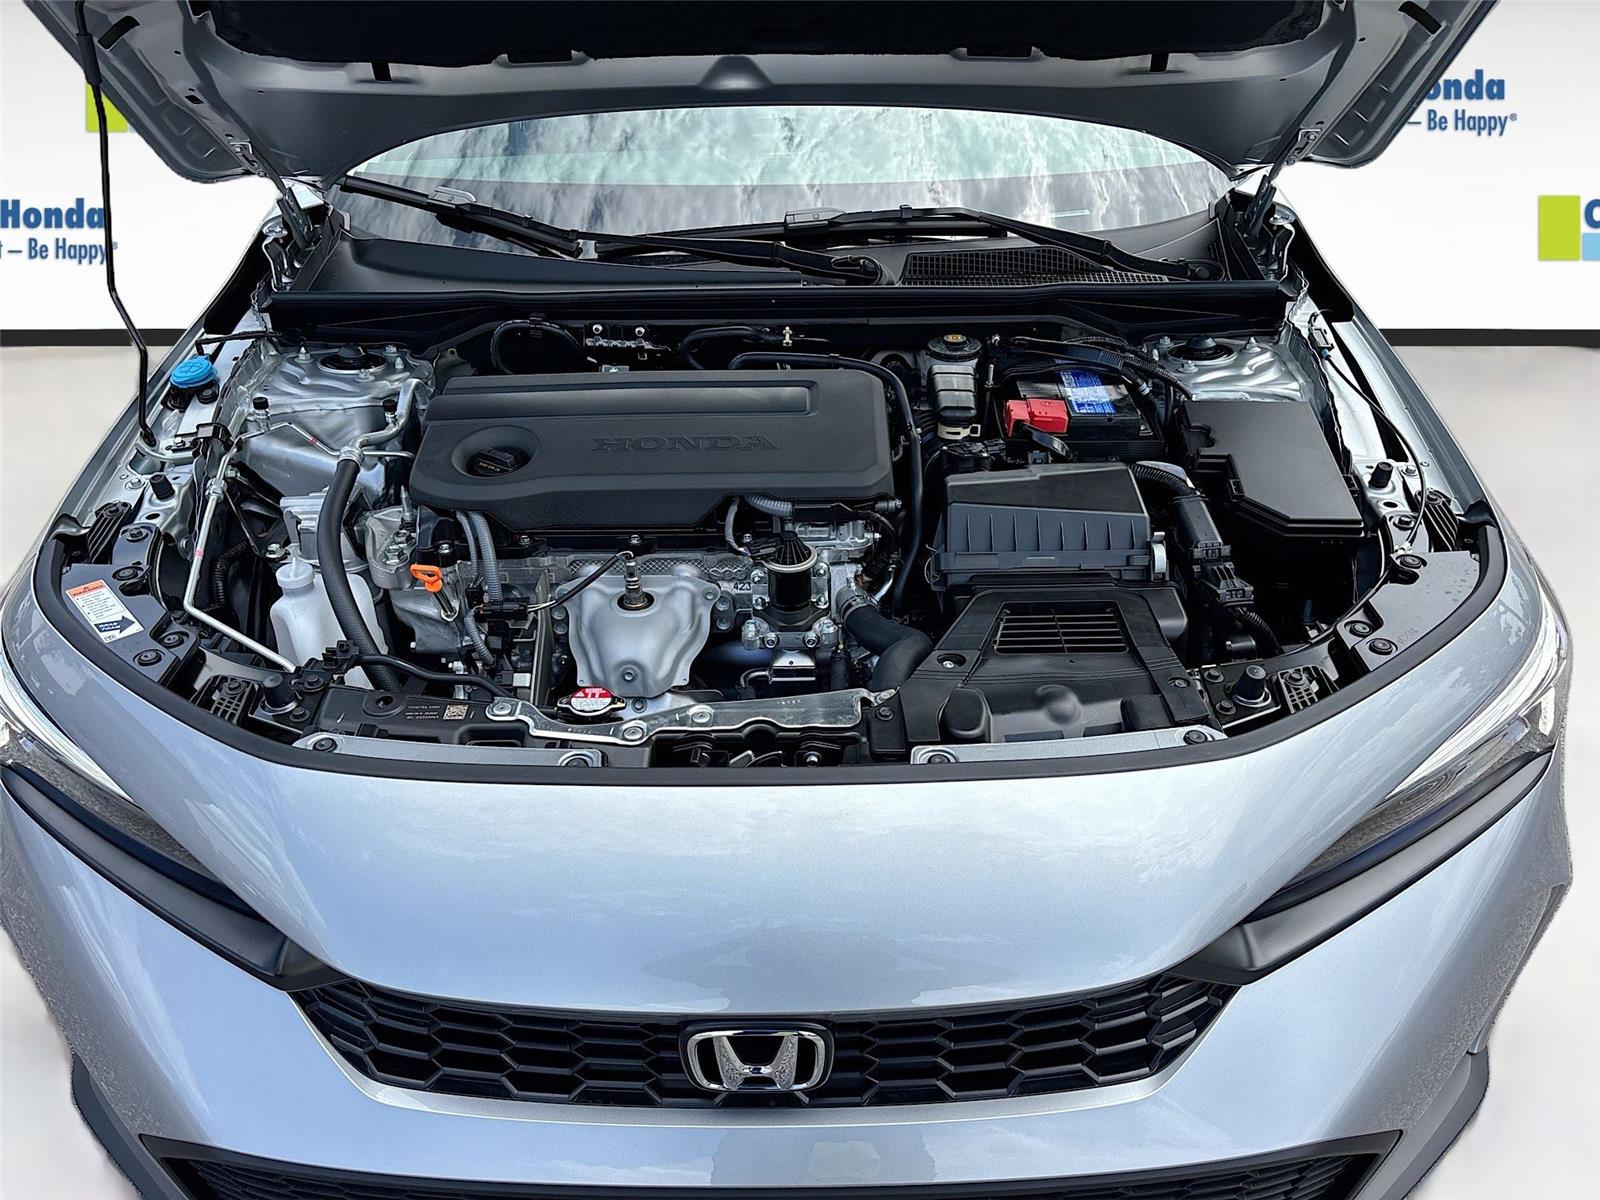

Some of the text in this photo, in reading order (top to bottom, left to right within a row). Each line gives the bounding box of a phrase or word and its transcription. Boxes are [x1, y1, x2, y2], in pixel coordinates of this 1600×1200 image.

[1425, 68, 1505, 100] onda
[1427, 108, 1448, 131] Be
[0, 197, 105, 229] Honda
[28, 237, 49, 260] Be
[590, 435, 780, 453] HONDA
[733, 581, 752, 591] 423
